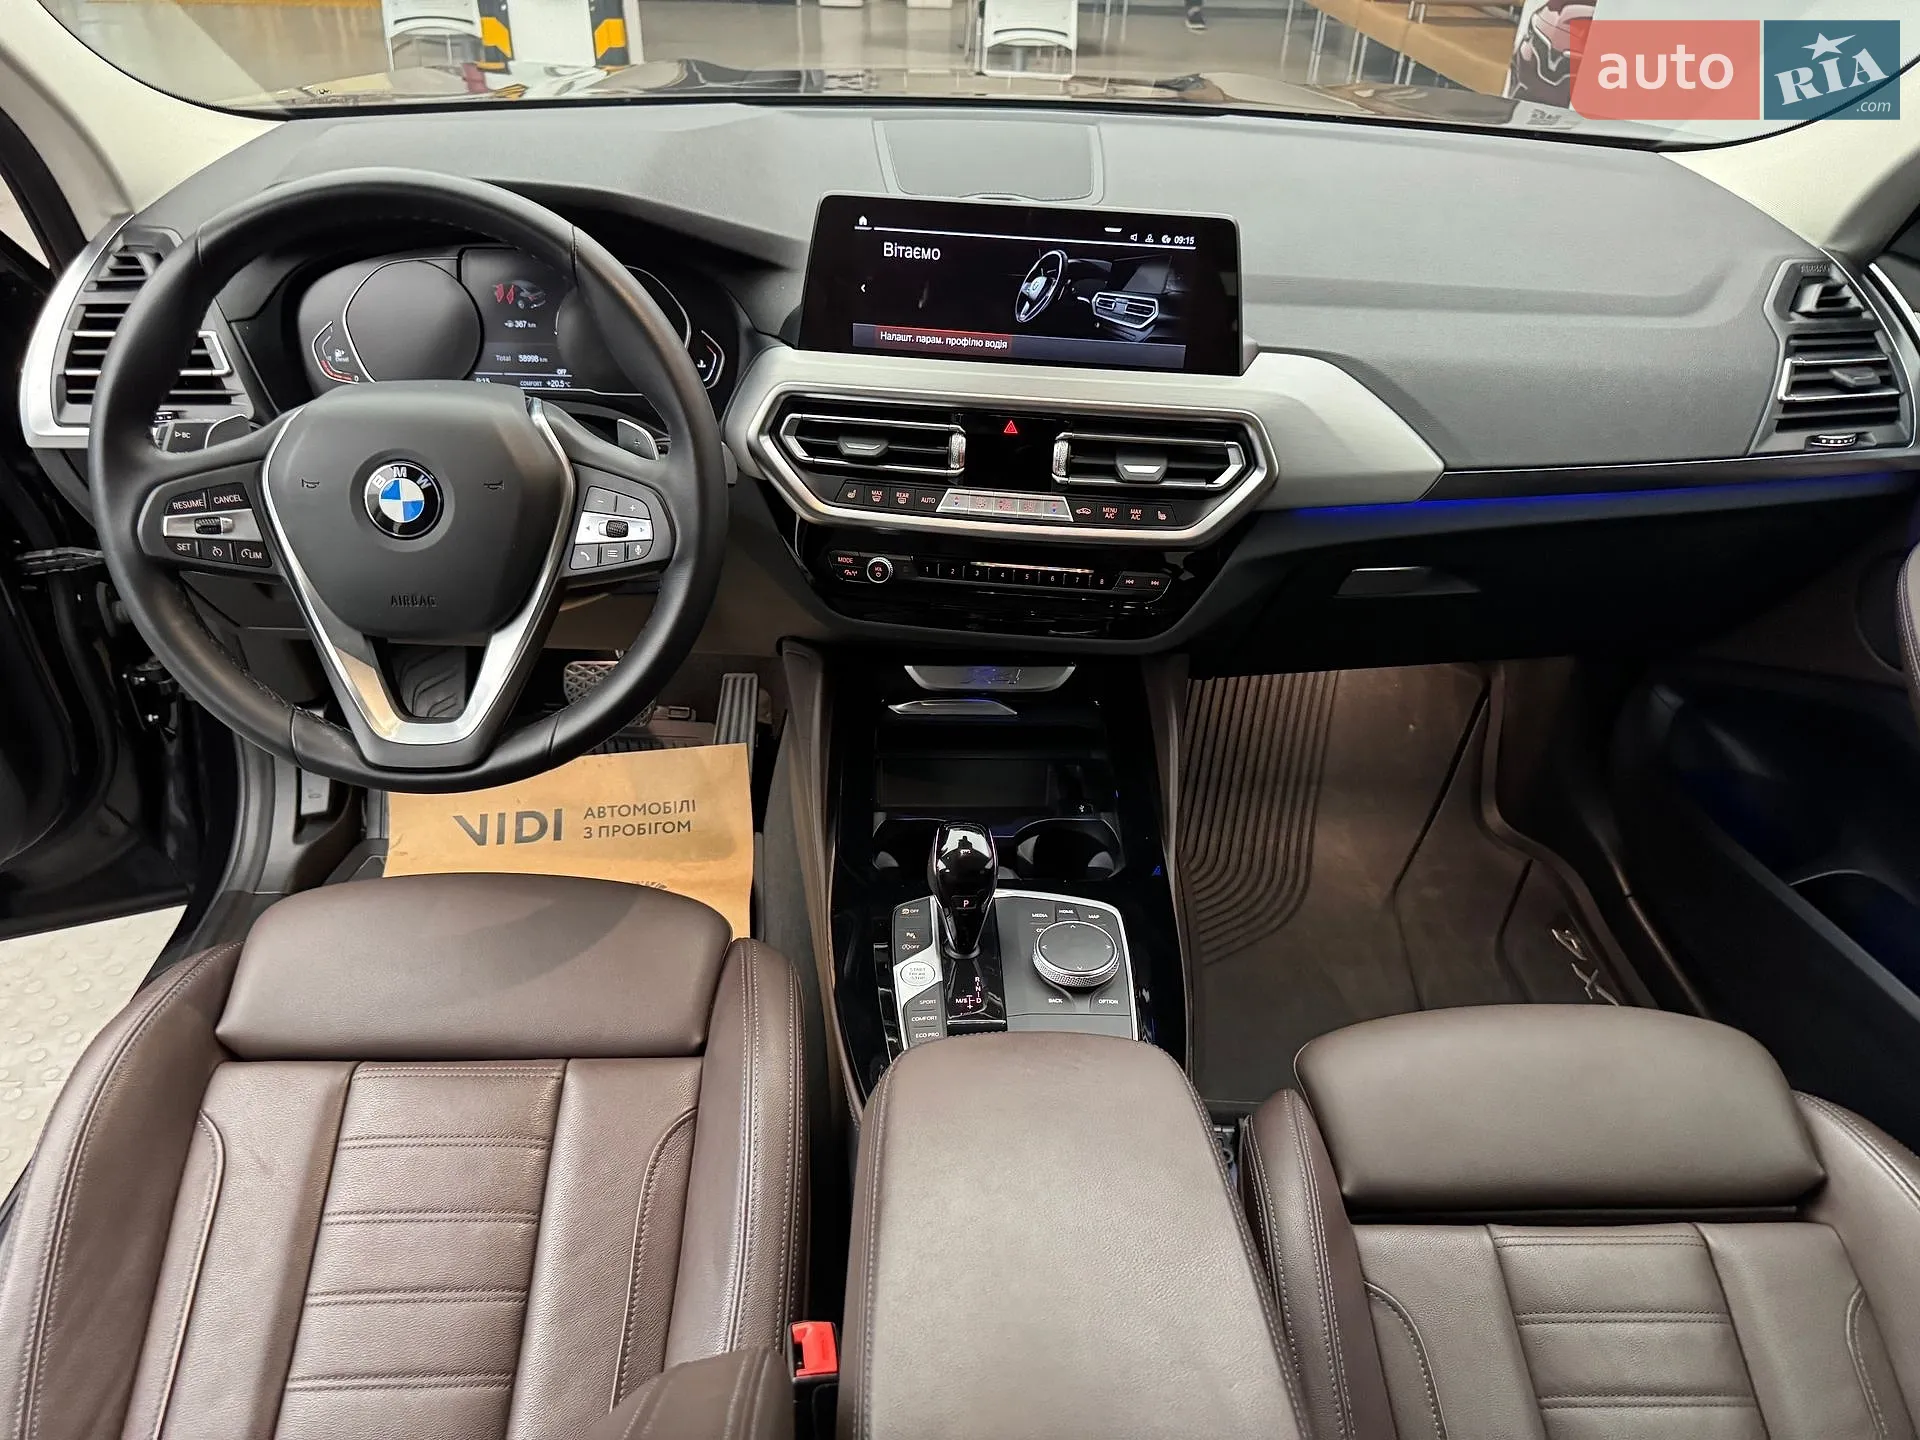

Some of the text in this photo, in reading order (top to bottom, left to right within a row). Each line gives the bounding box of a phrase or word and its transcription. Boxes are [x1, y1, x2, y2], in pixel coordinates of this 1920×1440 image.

[1174, 235, 1195, 245] 09:15
[883, 241, 941, 260] Вітаємо
[880, 331, 1008, 350] Налашт. парам. профілю водія
[372, 466, 432, 489] BMW
[172, 498, 204, 510] RESUME
[213, 494, 243, 505] CANCEL
[920, 496, 936, 504] AUTO
[176, 542, 192, 551] SET
[390, 594, 438, 609] AIRBAG
[583, 799, 696, 820] АВТОМОБІЛІ
[452, 808, 563, 846] VIDI
[598, 820, 692, 839] ПРОБІГОМ
[963, 900, 970, 908] P
